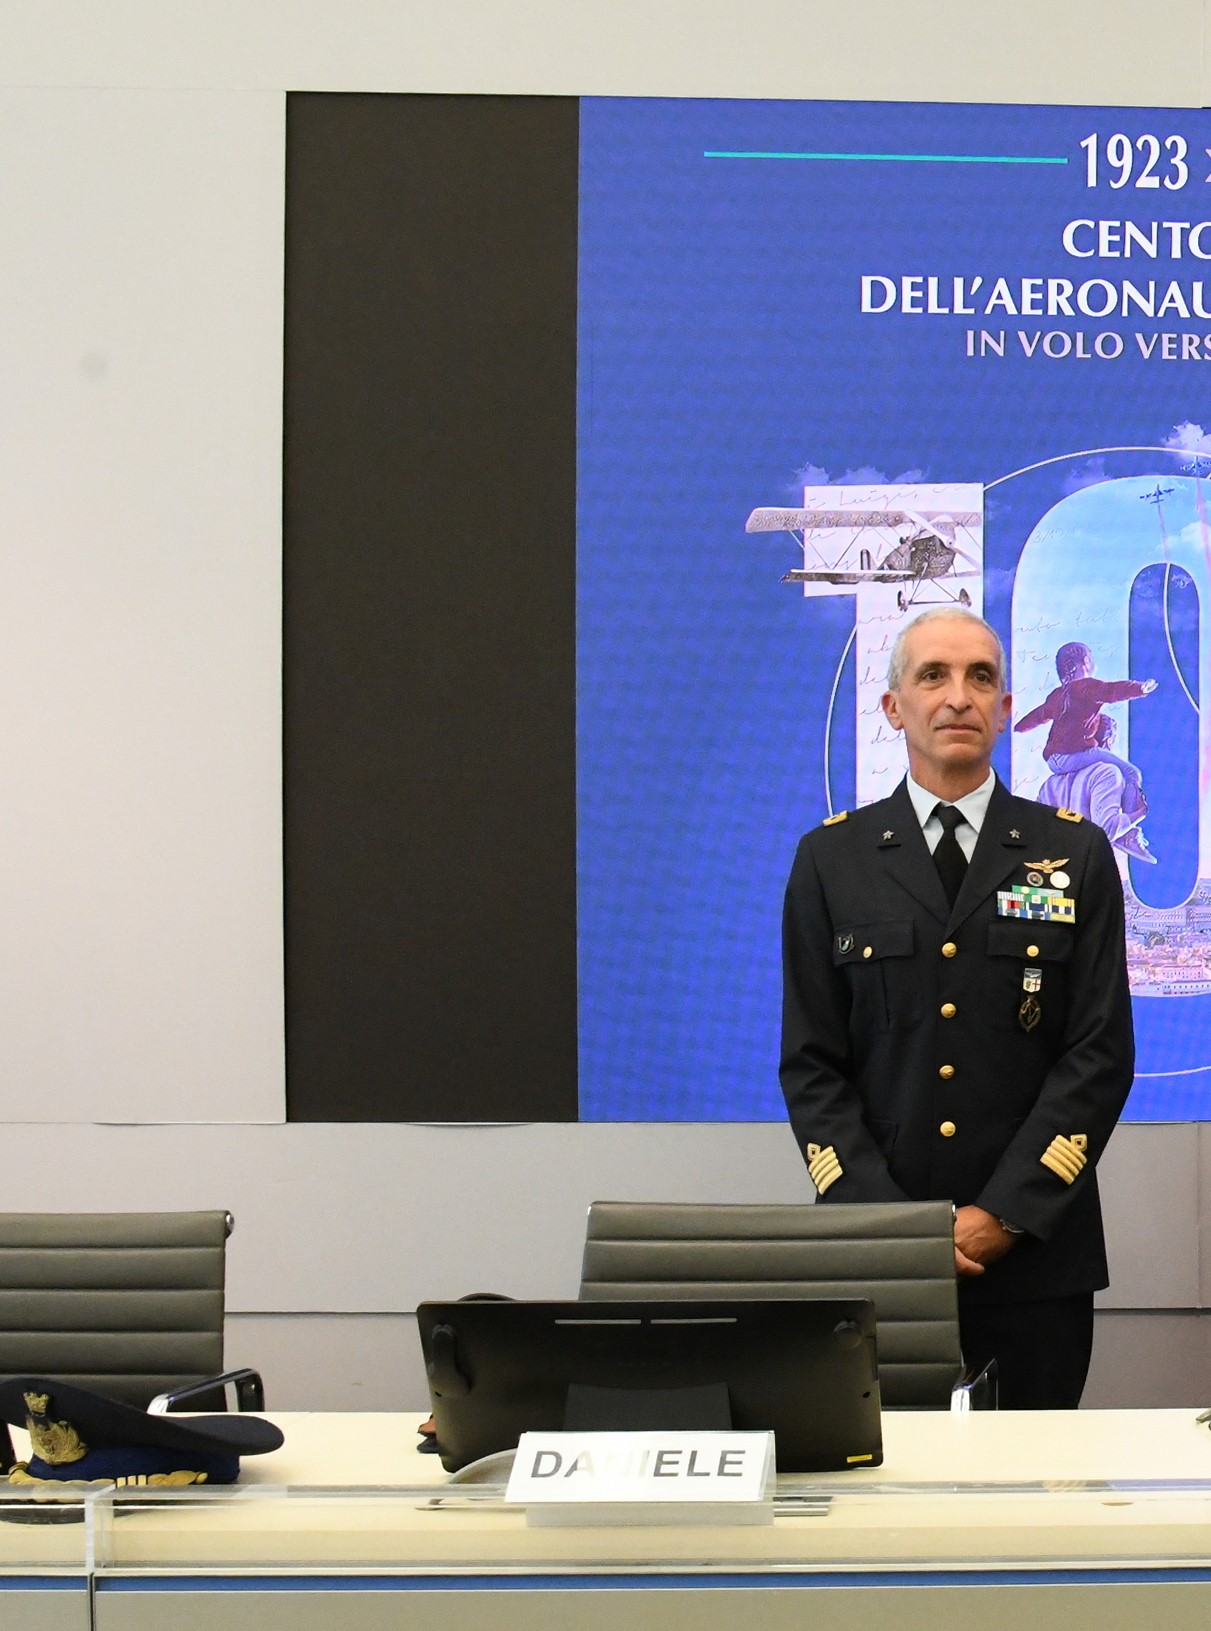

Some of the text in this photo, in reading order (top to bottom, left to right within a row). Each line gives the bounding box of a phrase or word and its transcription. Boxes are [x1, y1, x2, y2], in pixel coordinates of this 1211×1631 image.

[1080, 133, 1188, 191] 1923
[966, 329, 1004, 357] IN
[1018, 330, 1124, 360] VOLO
[530, 1449, 747, 1479] DAIELE
